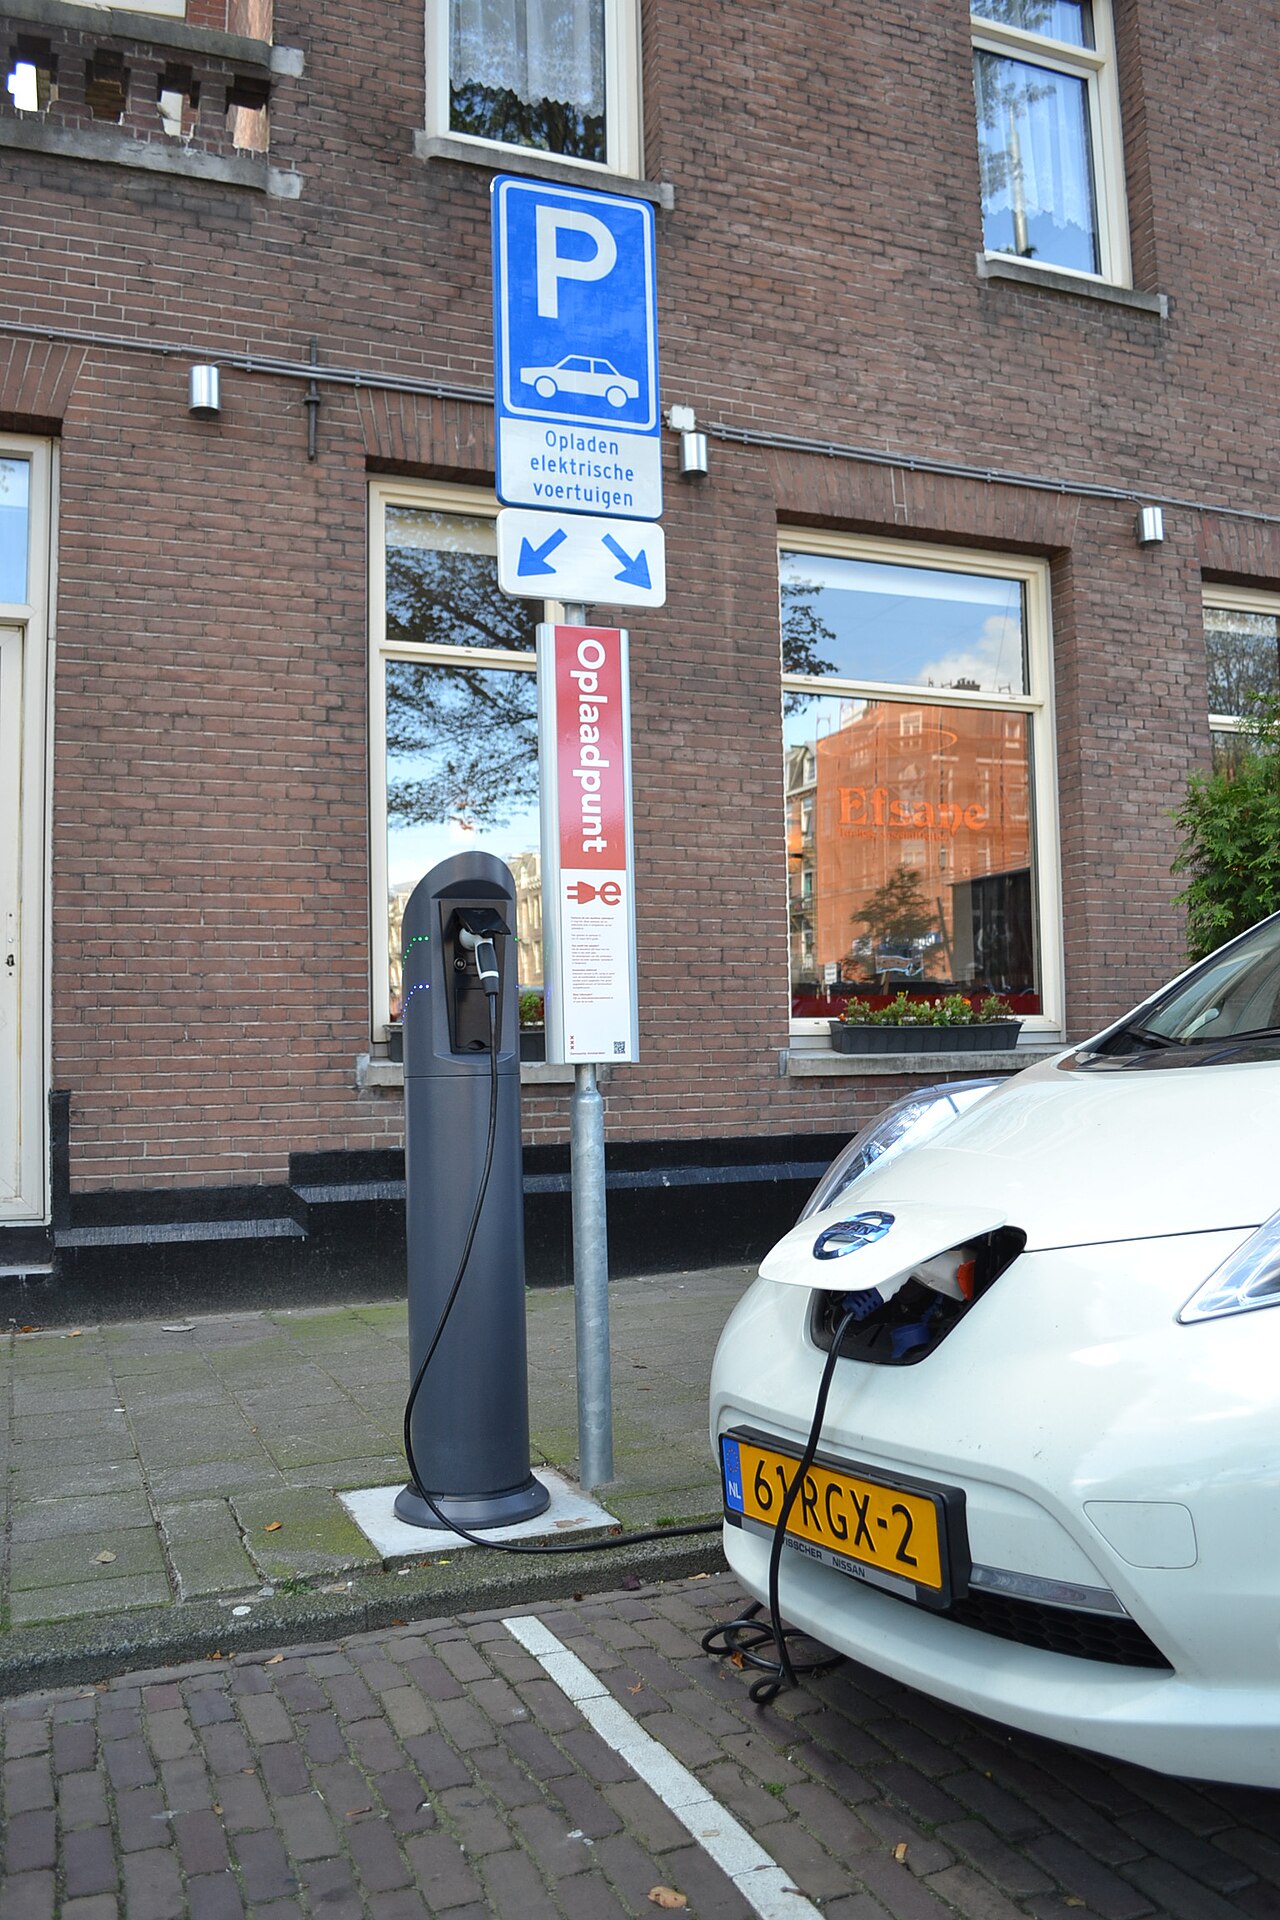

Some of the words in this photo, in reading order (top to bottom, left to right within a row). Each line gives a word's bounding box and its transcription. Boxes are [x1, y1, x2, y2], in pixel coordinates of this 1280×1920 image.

[536, 205, 617, 319] P
[545, 430, 619, 456] Opladen
[530, 455, 634, 482] elektrische
[533, 482, 634, 510] voertuigen
[570, 639, 609, 853] Oplaadpunt
[838, 786, 988, 836] Efsane
[728, 1480, 742, 1500] NL
[784, 1538, 823, 1560] ISSCHER
[832, 1557, 865, 1577] NISSAN
